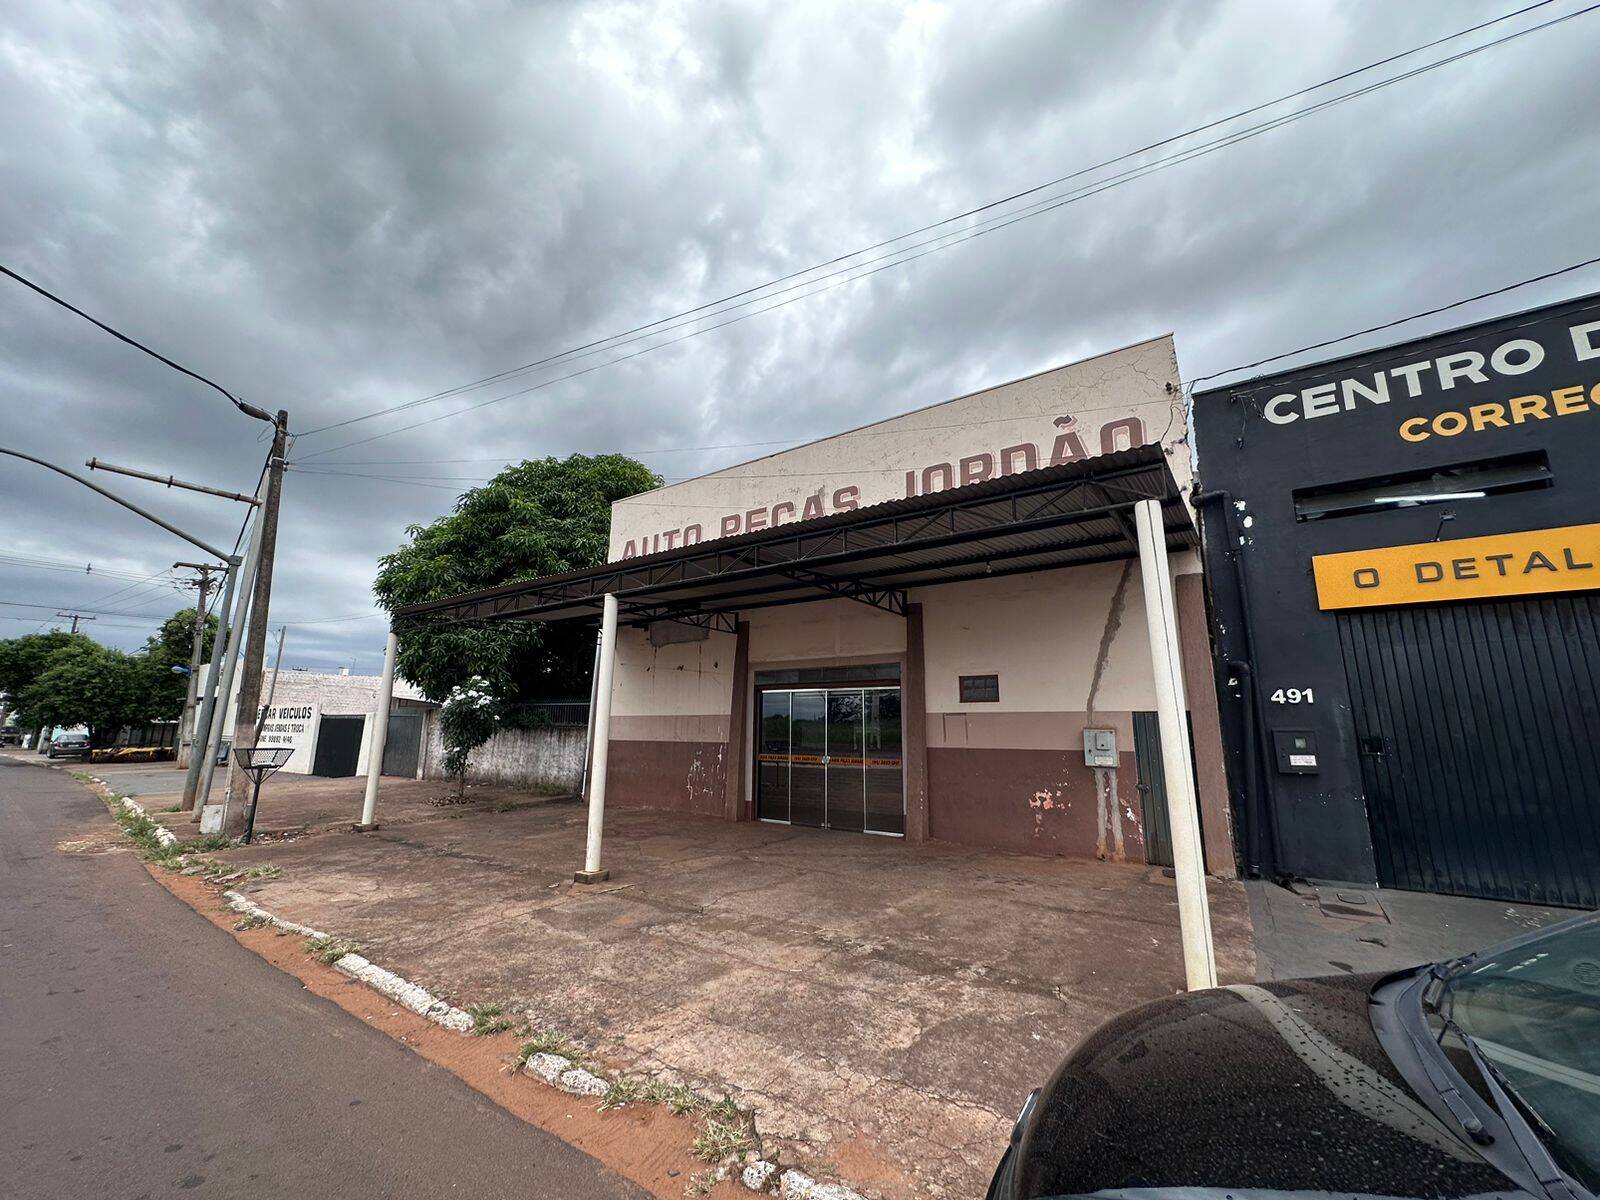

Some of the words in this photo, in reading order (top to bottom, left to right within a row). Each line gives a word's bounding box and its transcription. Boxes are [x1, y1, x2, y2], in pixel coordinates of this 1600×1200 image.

[1263, 338, 1546, 425] CENTRO
[1398, 382, 1600, 443] CORRE
[621, 523, 702, 561] AUTO
[1352, 567, 1380, 589] O
[1414, 547, 1594, 584] DETAL
[1270, 687, 1315, 705] 491
